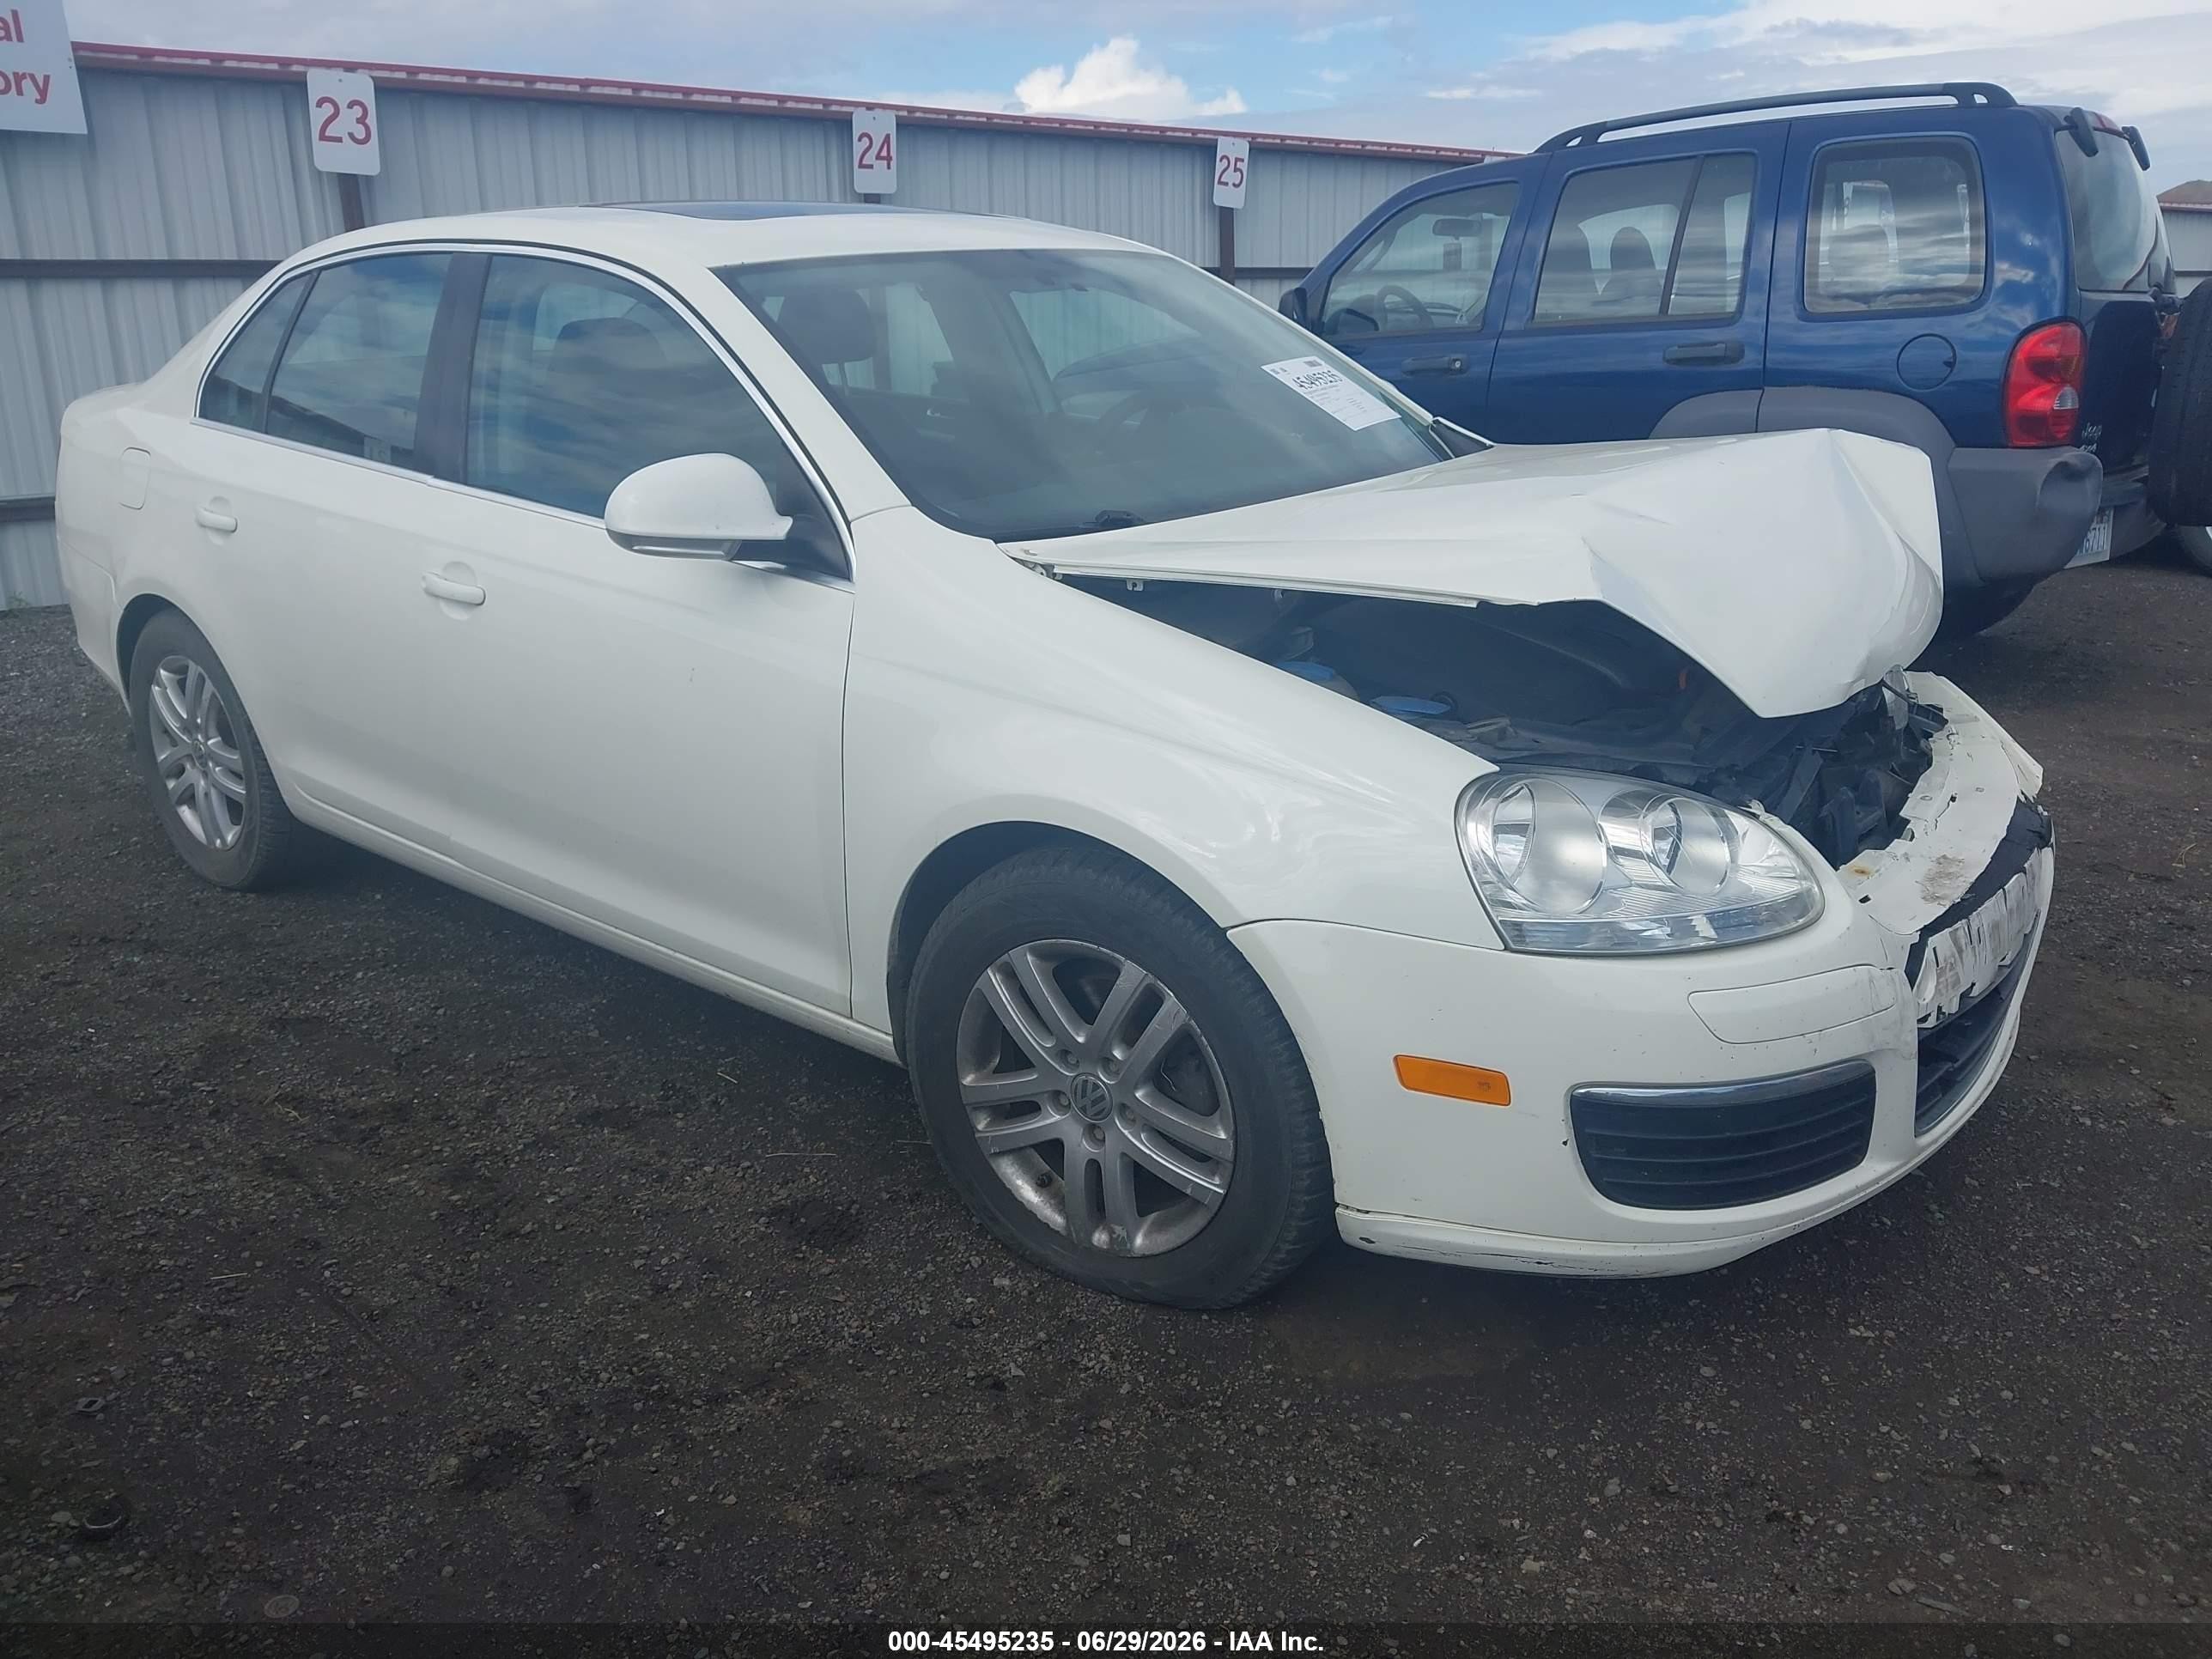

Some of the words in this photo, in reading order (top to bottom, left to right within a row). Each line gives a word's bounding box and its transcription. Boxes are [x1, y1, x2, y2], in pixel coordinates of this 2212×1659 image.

[316, 96, 372, 145] 23
[857, 132, 894, 170] 24
[1216, 155, 1245, 188] 25
